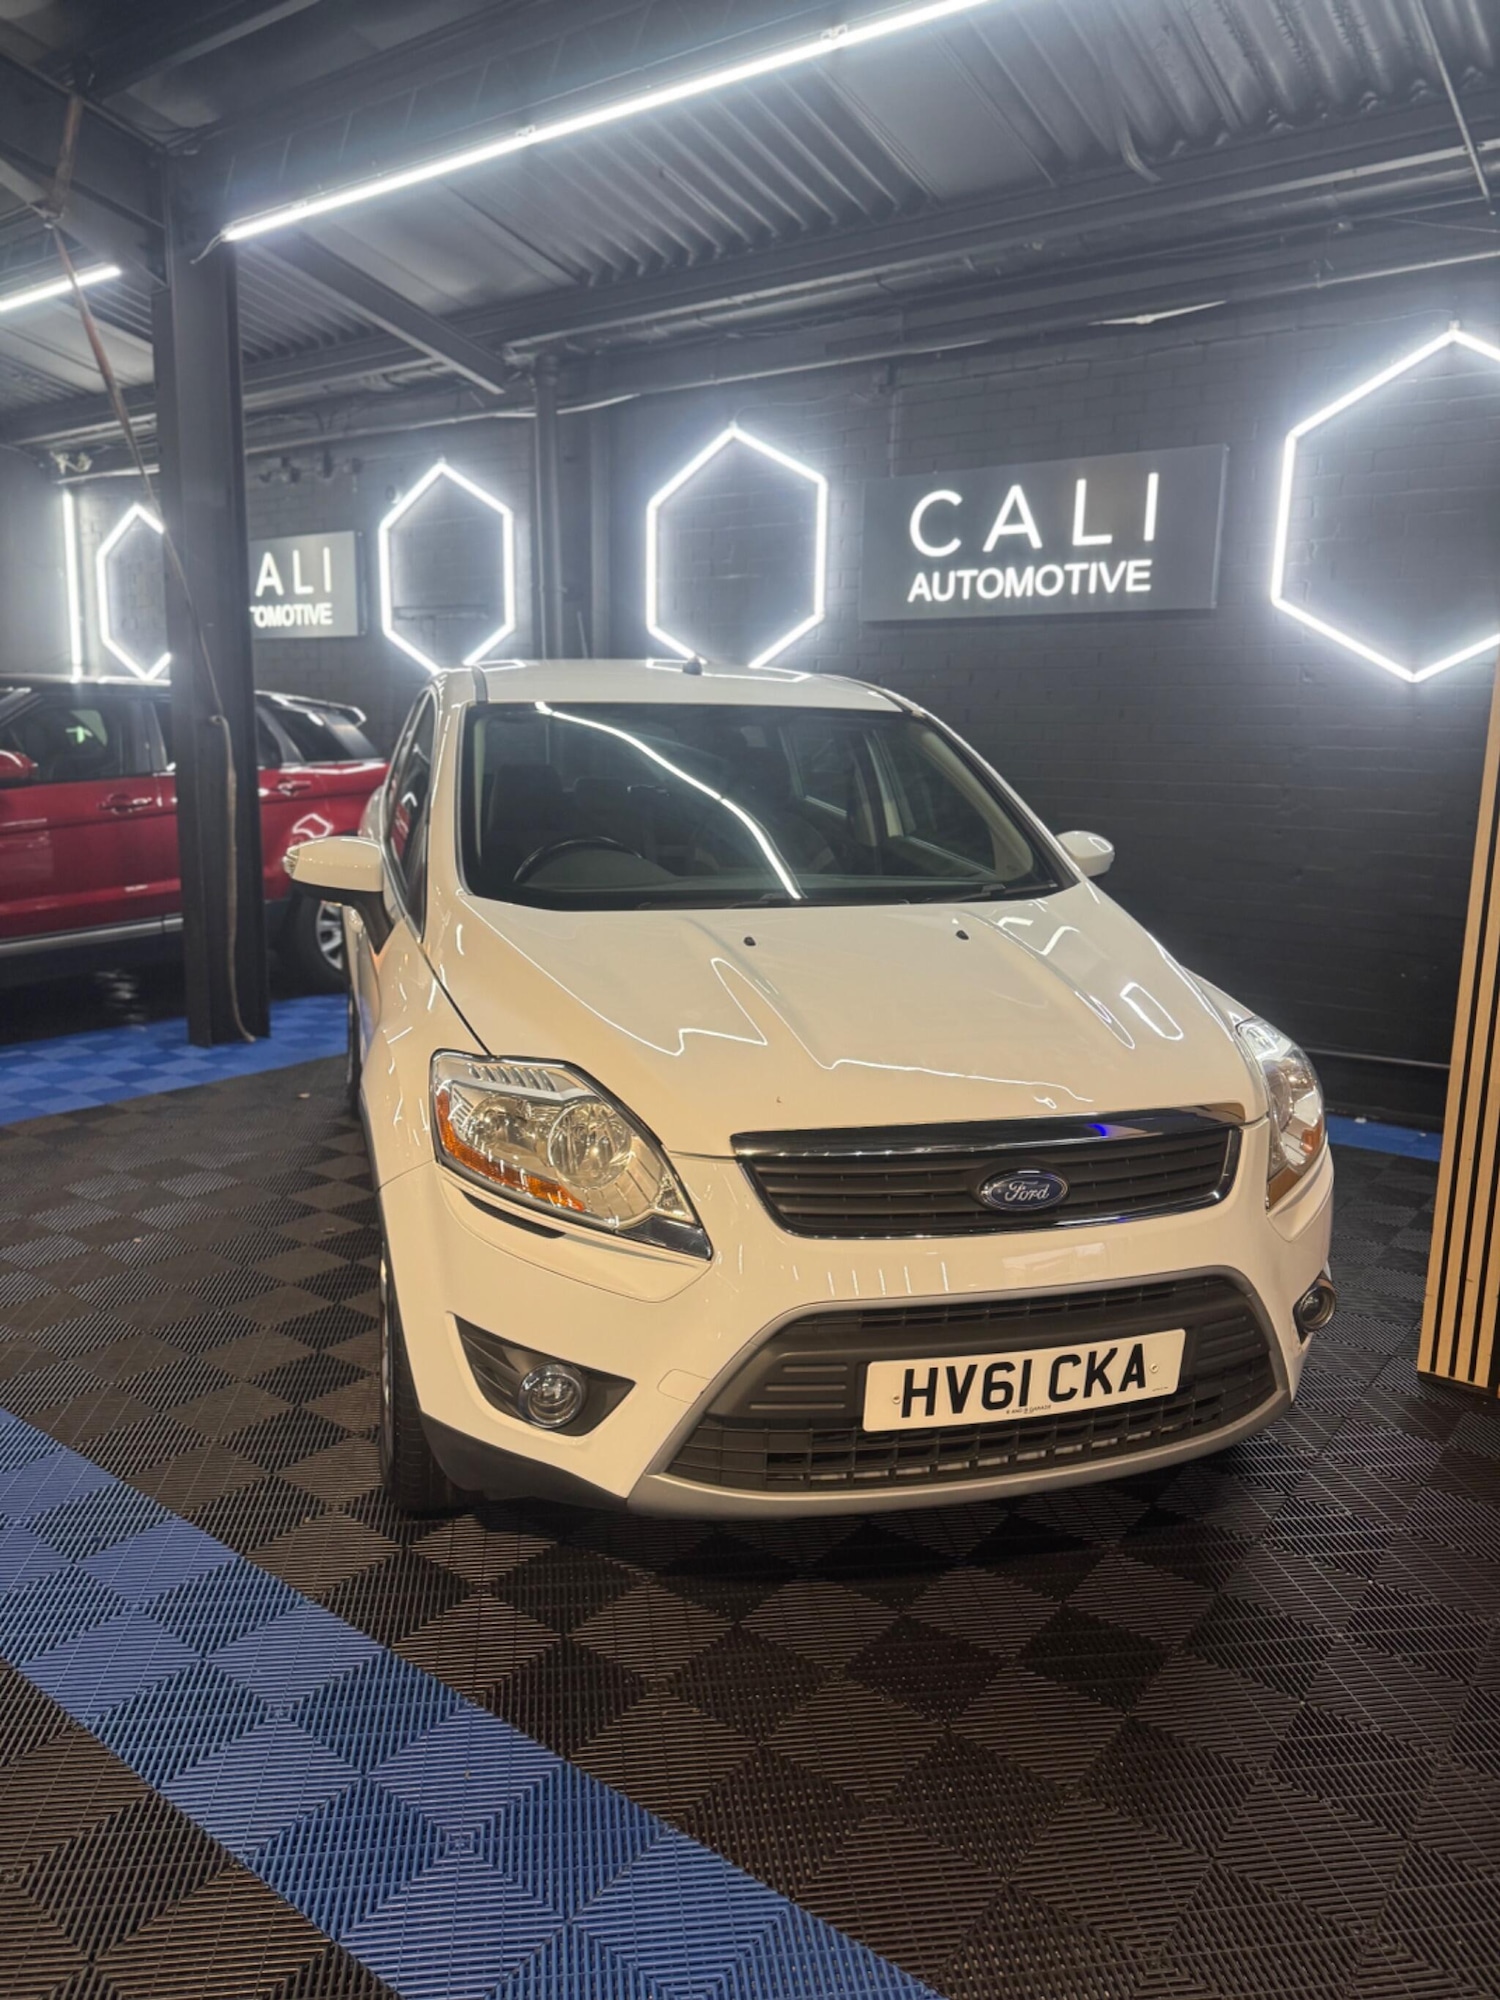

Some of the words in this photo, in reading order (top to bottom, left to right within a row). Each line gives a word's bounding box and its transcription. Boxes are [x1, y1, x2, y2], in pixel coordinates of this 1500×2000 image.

[909, 472, 1160, 557] CALI
[255, 546, 332, 598] ALI
[907, 559, 1153, 602] AUTOMOTIVE
[249, 602, 333, 628] OMOTIVE
[1004, 1180, 1050, 1202] Ford
[900, 1358, 1033, 1418] HV61
[1048, 1343, 1147, 1403] CKA
